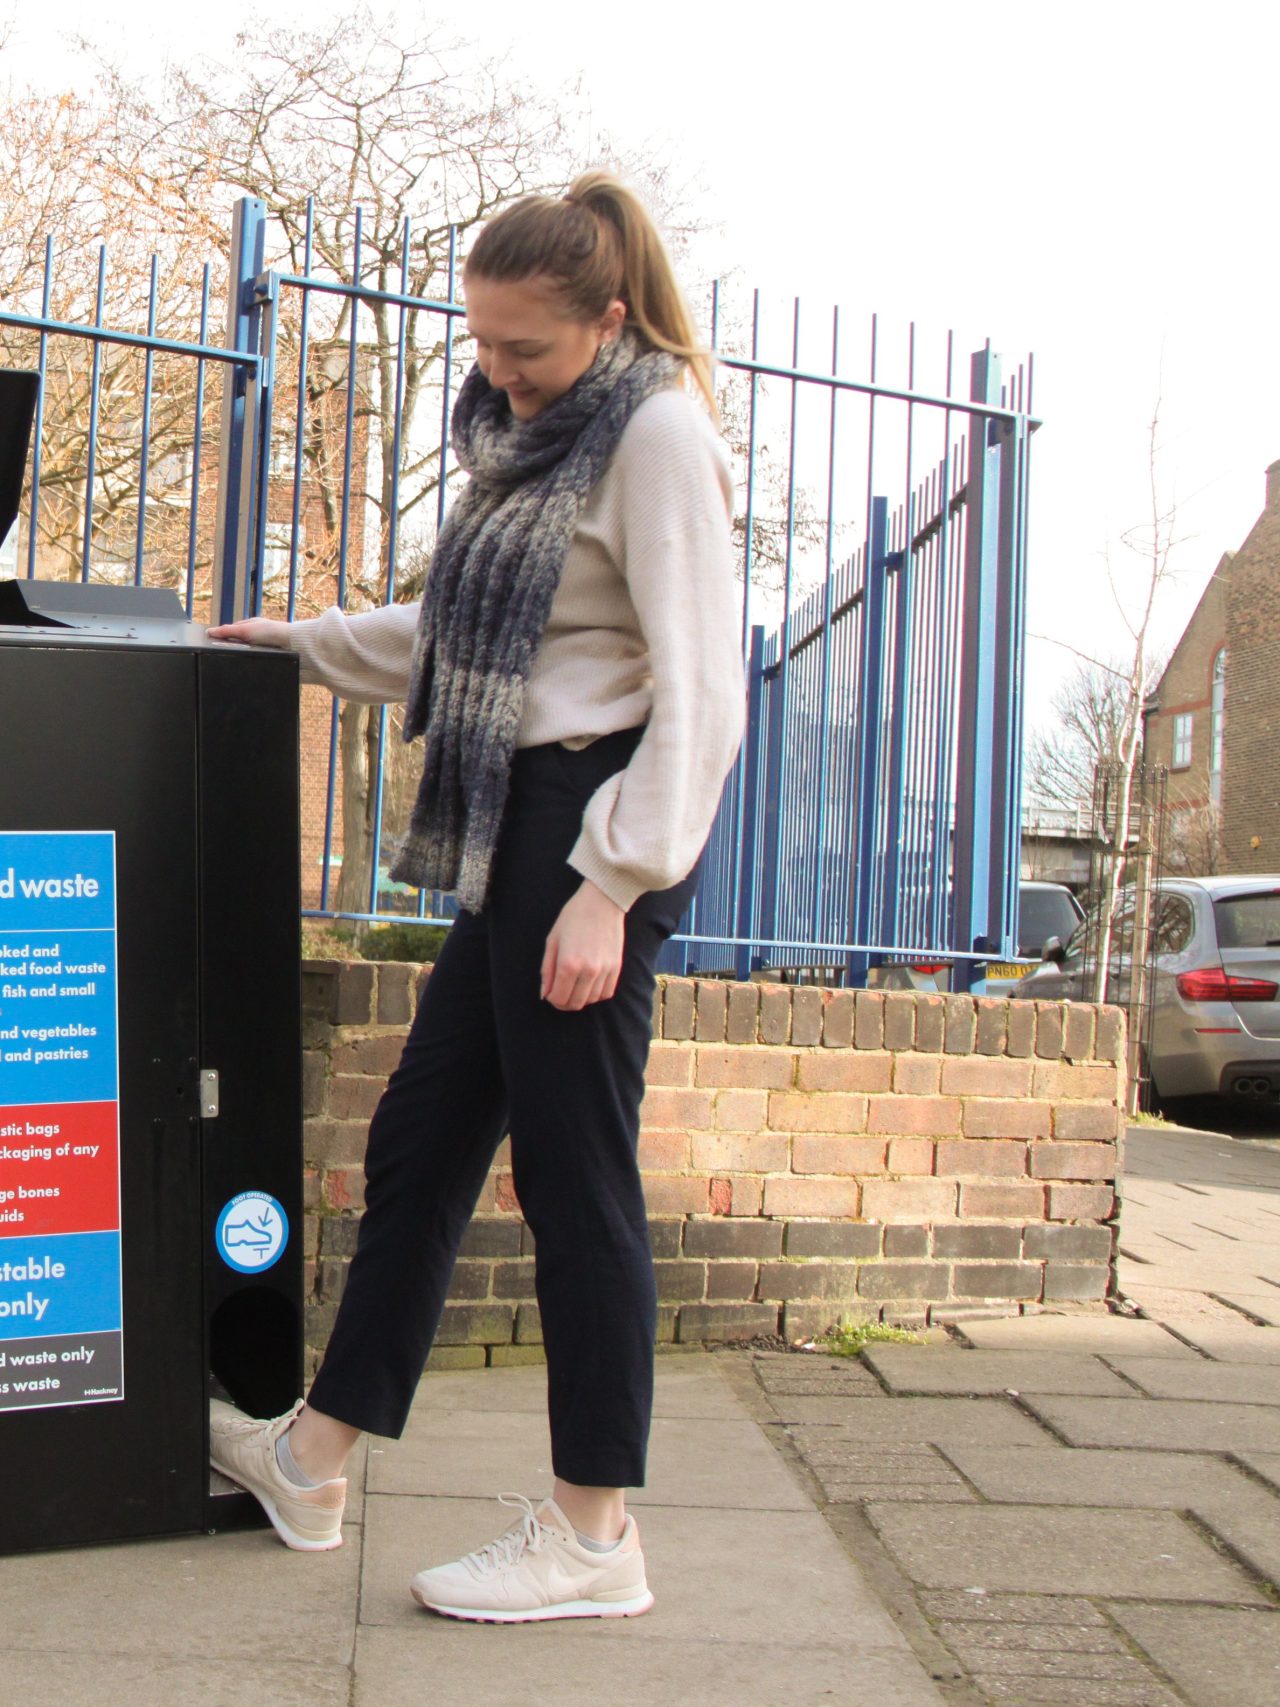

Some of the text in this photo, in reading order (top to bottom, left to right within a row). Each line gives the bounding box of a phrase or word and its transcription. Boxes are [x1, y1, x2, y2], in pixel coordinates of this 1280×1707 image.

[20, 874, 99, 898] waste
[33, 944, 60, 957] and
[30, 963, 62, 976] food
[65, 963, 106, 975] waste
[2, 985, 28, 998] fish
[31, 984, 56, 997] and
[59, 982, 96, 996] small
[21, 1024, 97, 1041] vegetables
[5, 1048, 32, 1062] and
[35, 1047, 89, 1064] pastries
[26, 1123, 60, 1138] bags
[55, 1143, 70, 1156] of
[73, 1144, 99, 1158] any
[18, 1186, 60, 1199] bones
[10, 1351, 57, 1366] waste
[61, 1346, 95, 1364] only
[13, 1377, 61, 1392] waste
